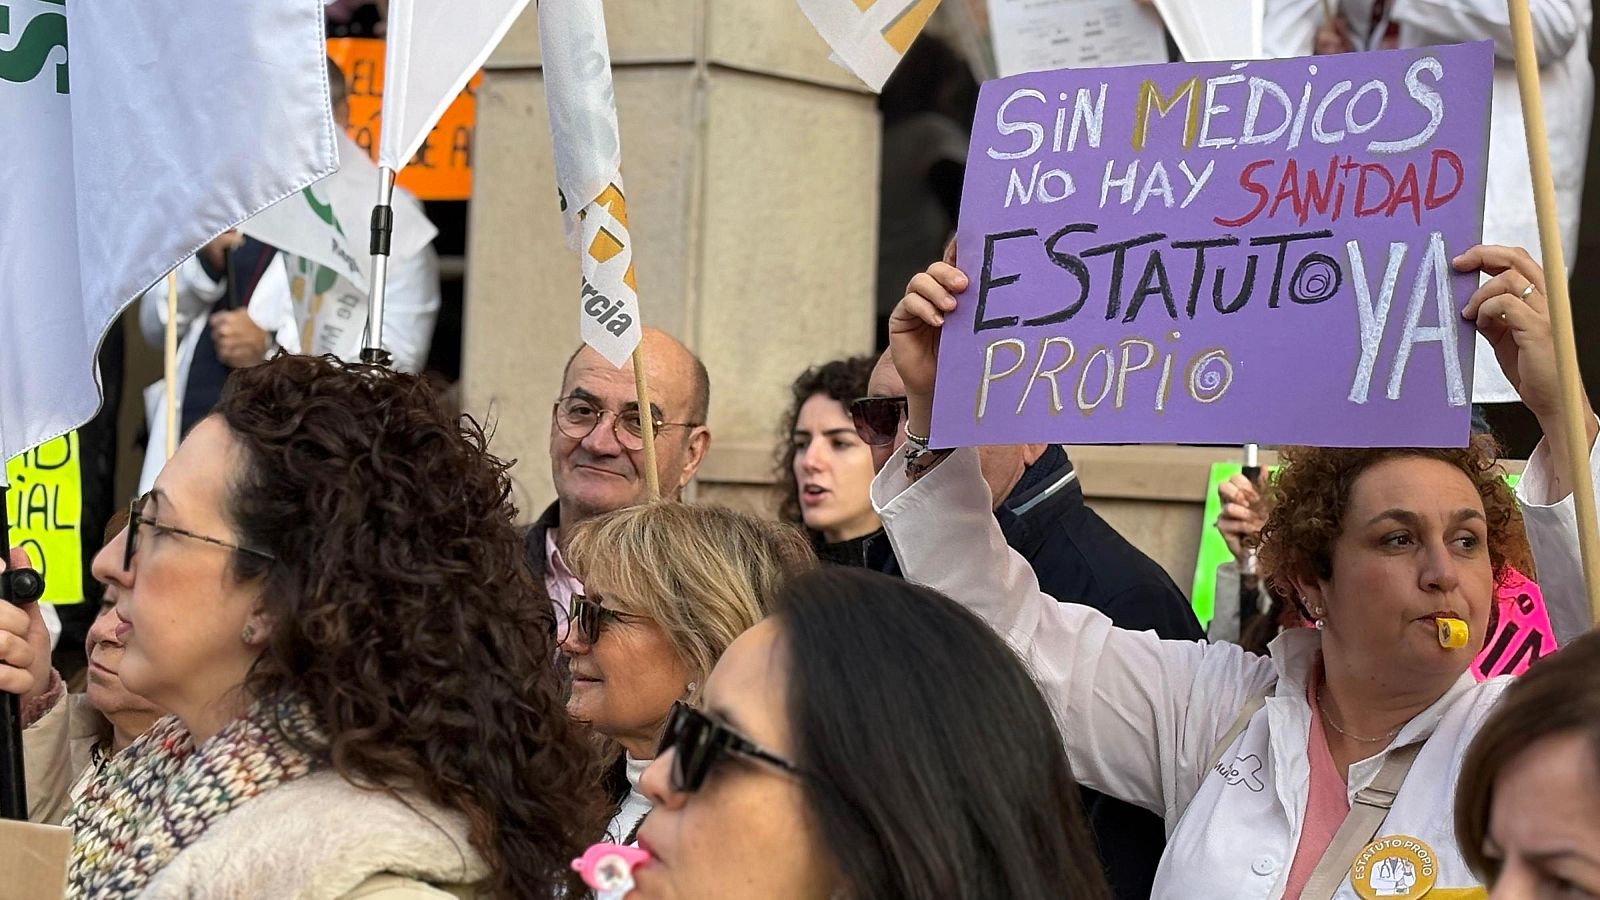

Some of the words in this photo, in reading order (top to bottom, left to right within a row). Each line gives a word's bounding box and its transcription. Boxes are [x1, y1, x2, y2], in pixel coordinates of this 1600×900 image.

[1003, 160, 1077, 208] NO
[1099, 159, 1215, 216] HAY
[974, 223, 1343, 334] ESTATUTO
[1346, 231, 1467, 406] YA
[1355, 840, 1403, 880] ESTATUTO
[1403, 840, 1433, 877] PROPIO
